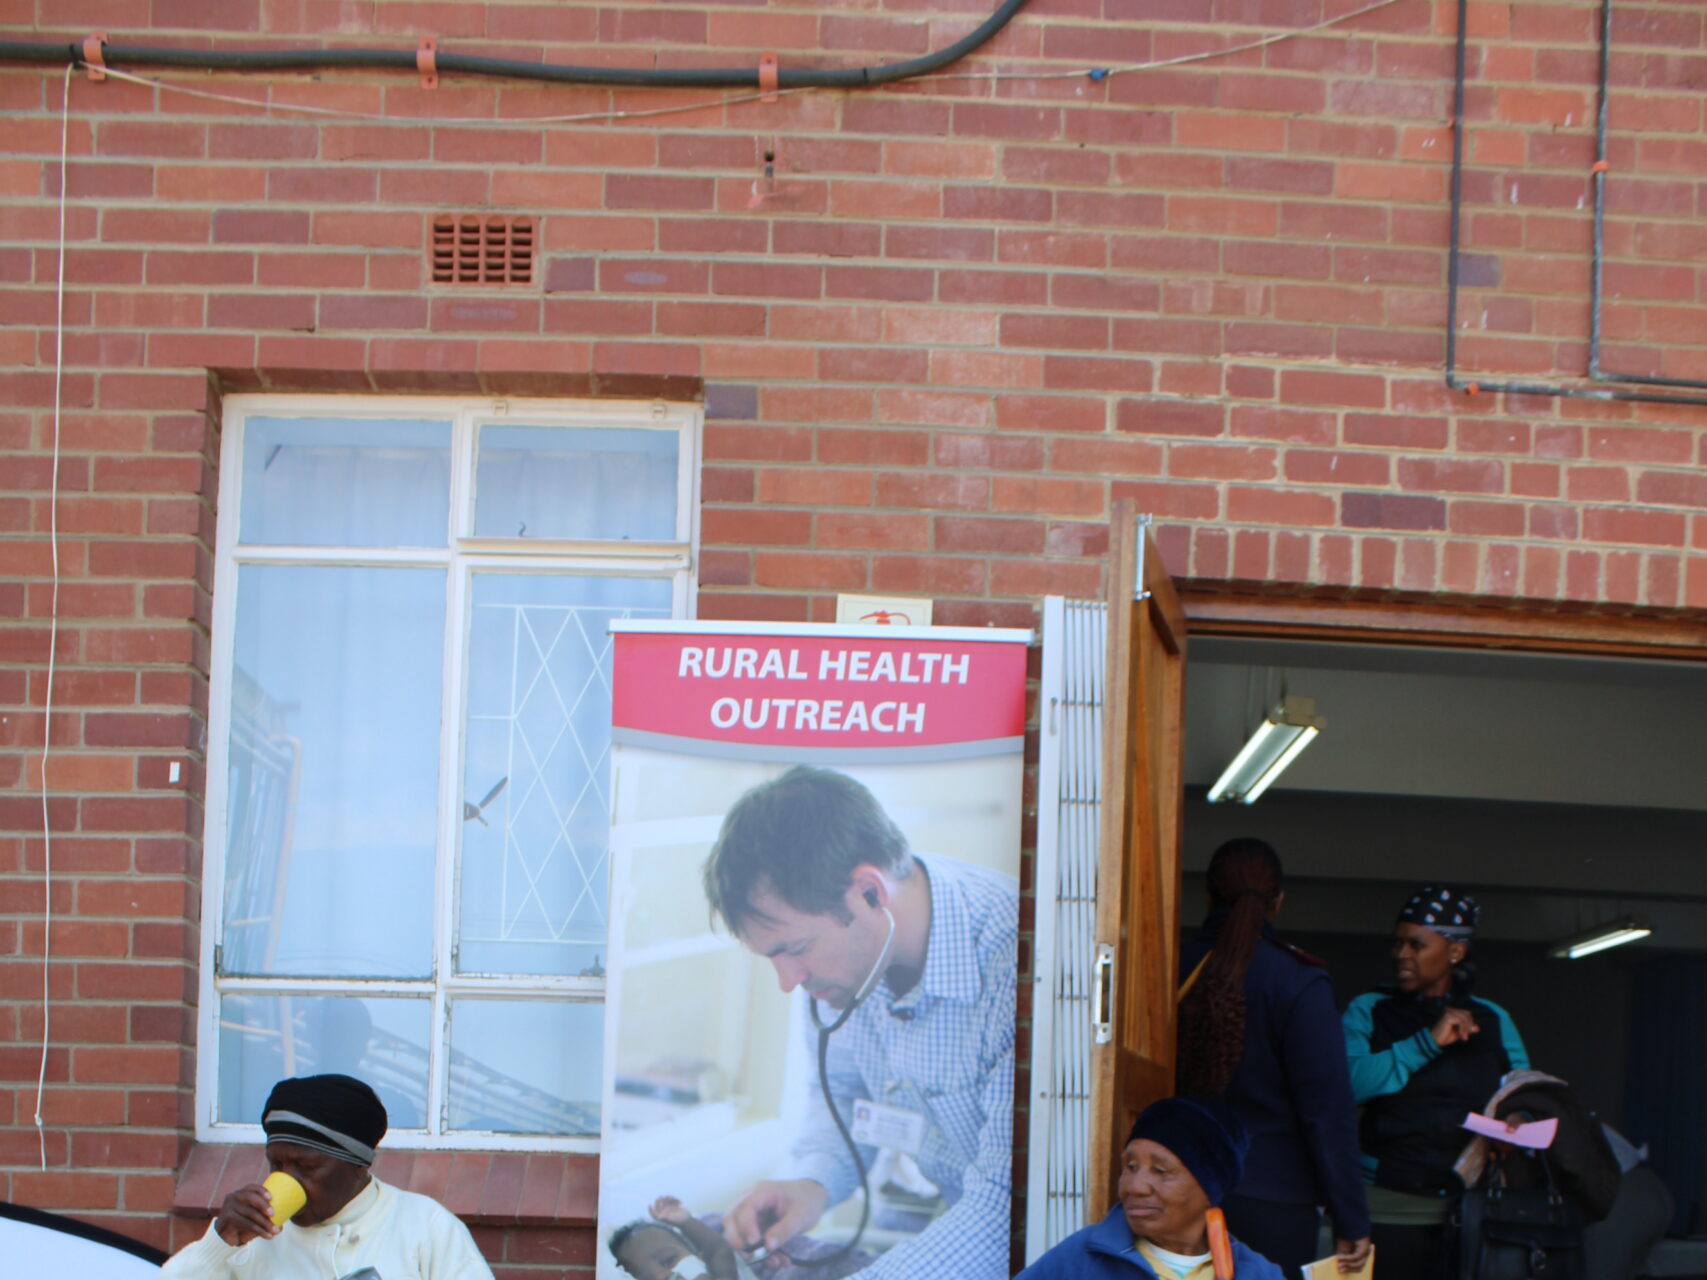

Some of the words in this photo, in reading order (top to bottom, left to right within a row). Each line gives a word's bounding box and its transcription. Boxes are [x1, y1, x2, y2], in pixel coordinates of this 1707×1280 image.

[678, 646, 808, 680] RURAL
[818, 650, 970, 685] HEALTH
[710, 697, 926, 733] OUTREACH
